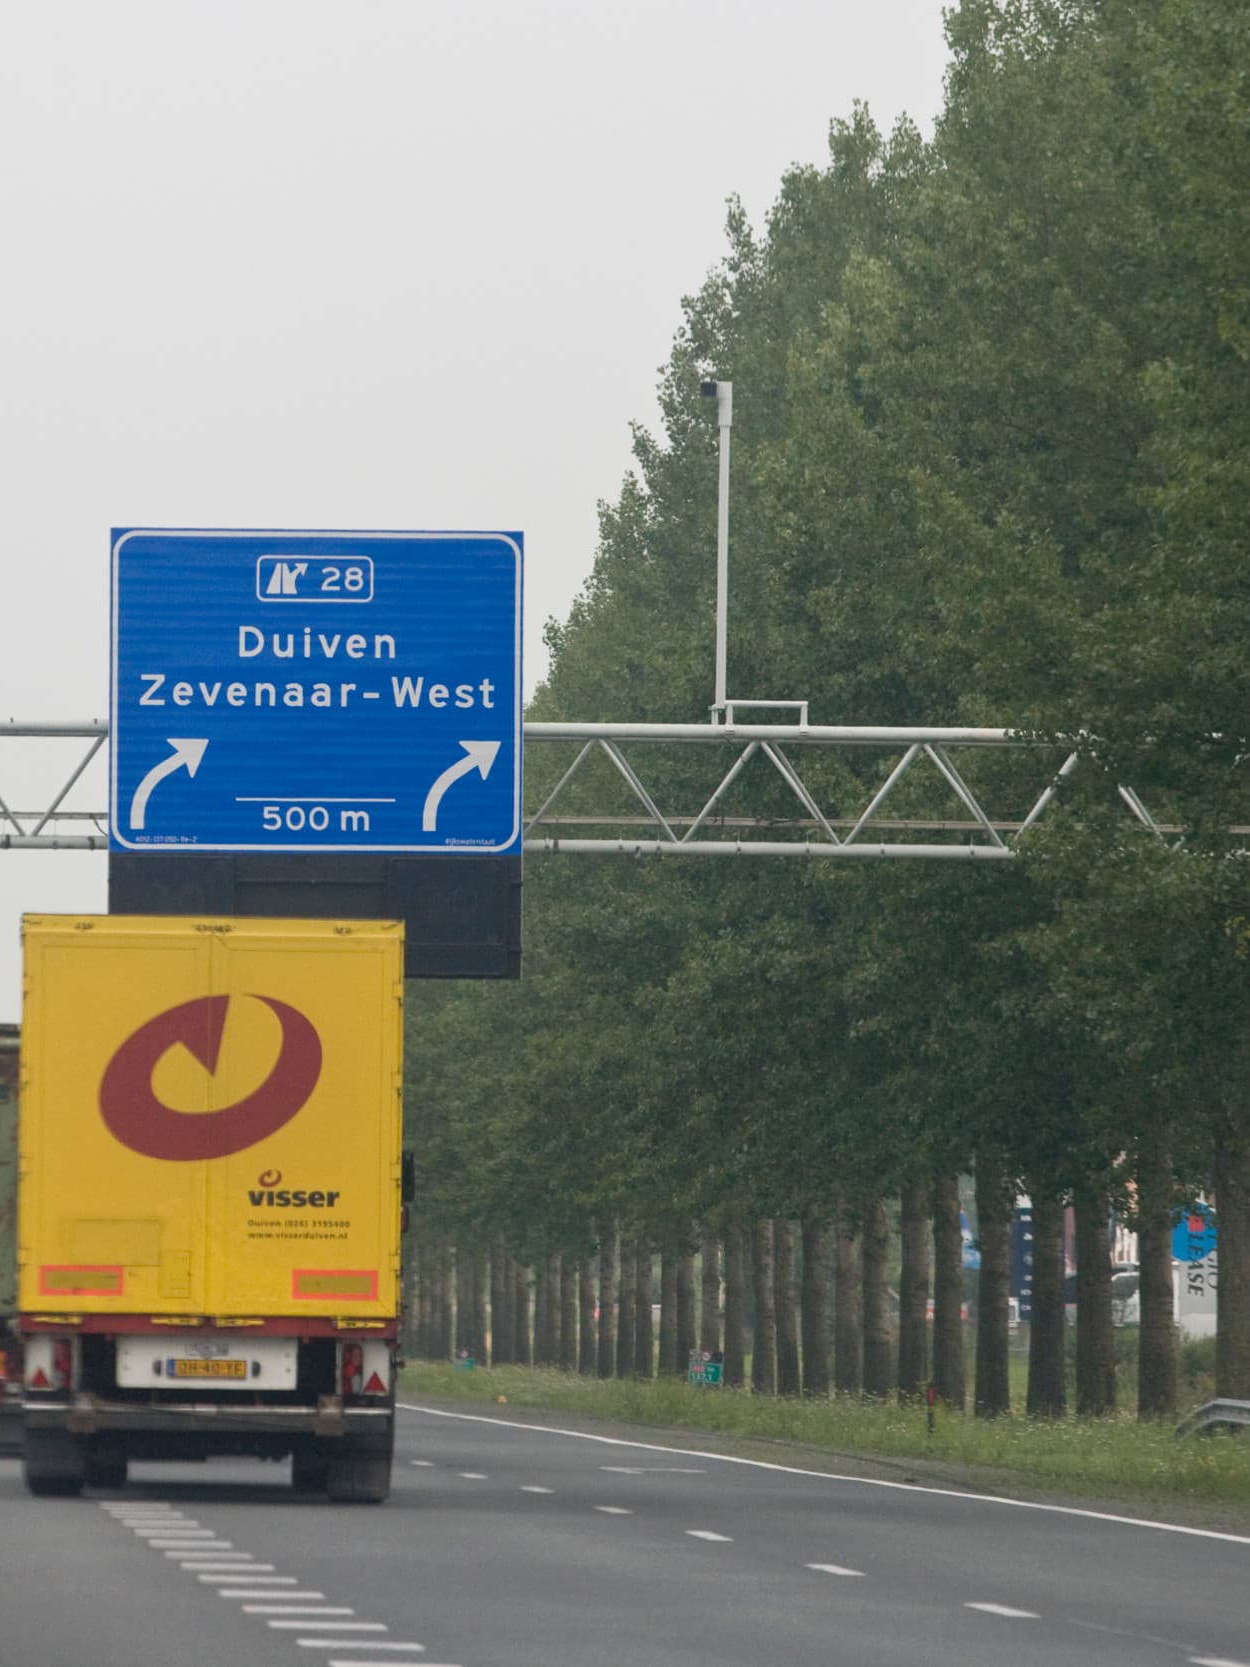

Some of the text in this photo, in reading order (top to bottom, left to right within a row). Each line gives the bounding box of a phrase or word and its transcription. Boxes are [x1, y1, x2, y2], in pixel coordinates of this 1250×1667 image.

[321, 567, 365, 591] 28
[238, 625, 397, 659] Duiven
[138, 673, 496, 709] Zevenaar-West
[262, 806, 371, 832] 500 m
[247, 1190, 341, 1208] visser
[247, 1219, 282, 1228] Duiven
[247, 1231, 349, 1240] www.visserduiven.nl
[1187, 1233, 1205, 1297] LEASE
